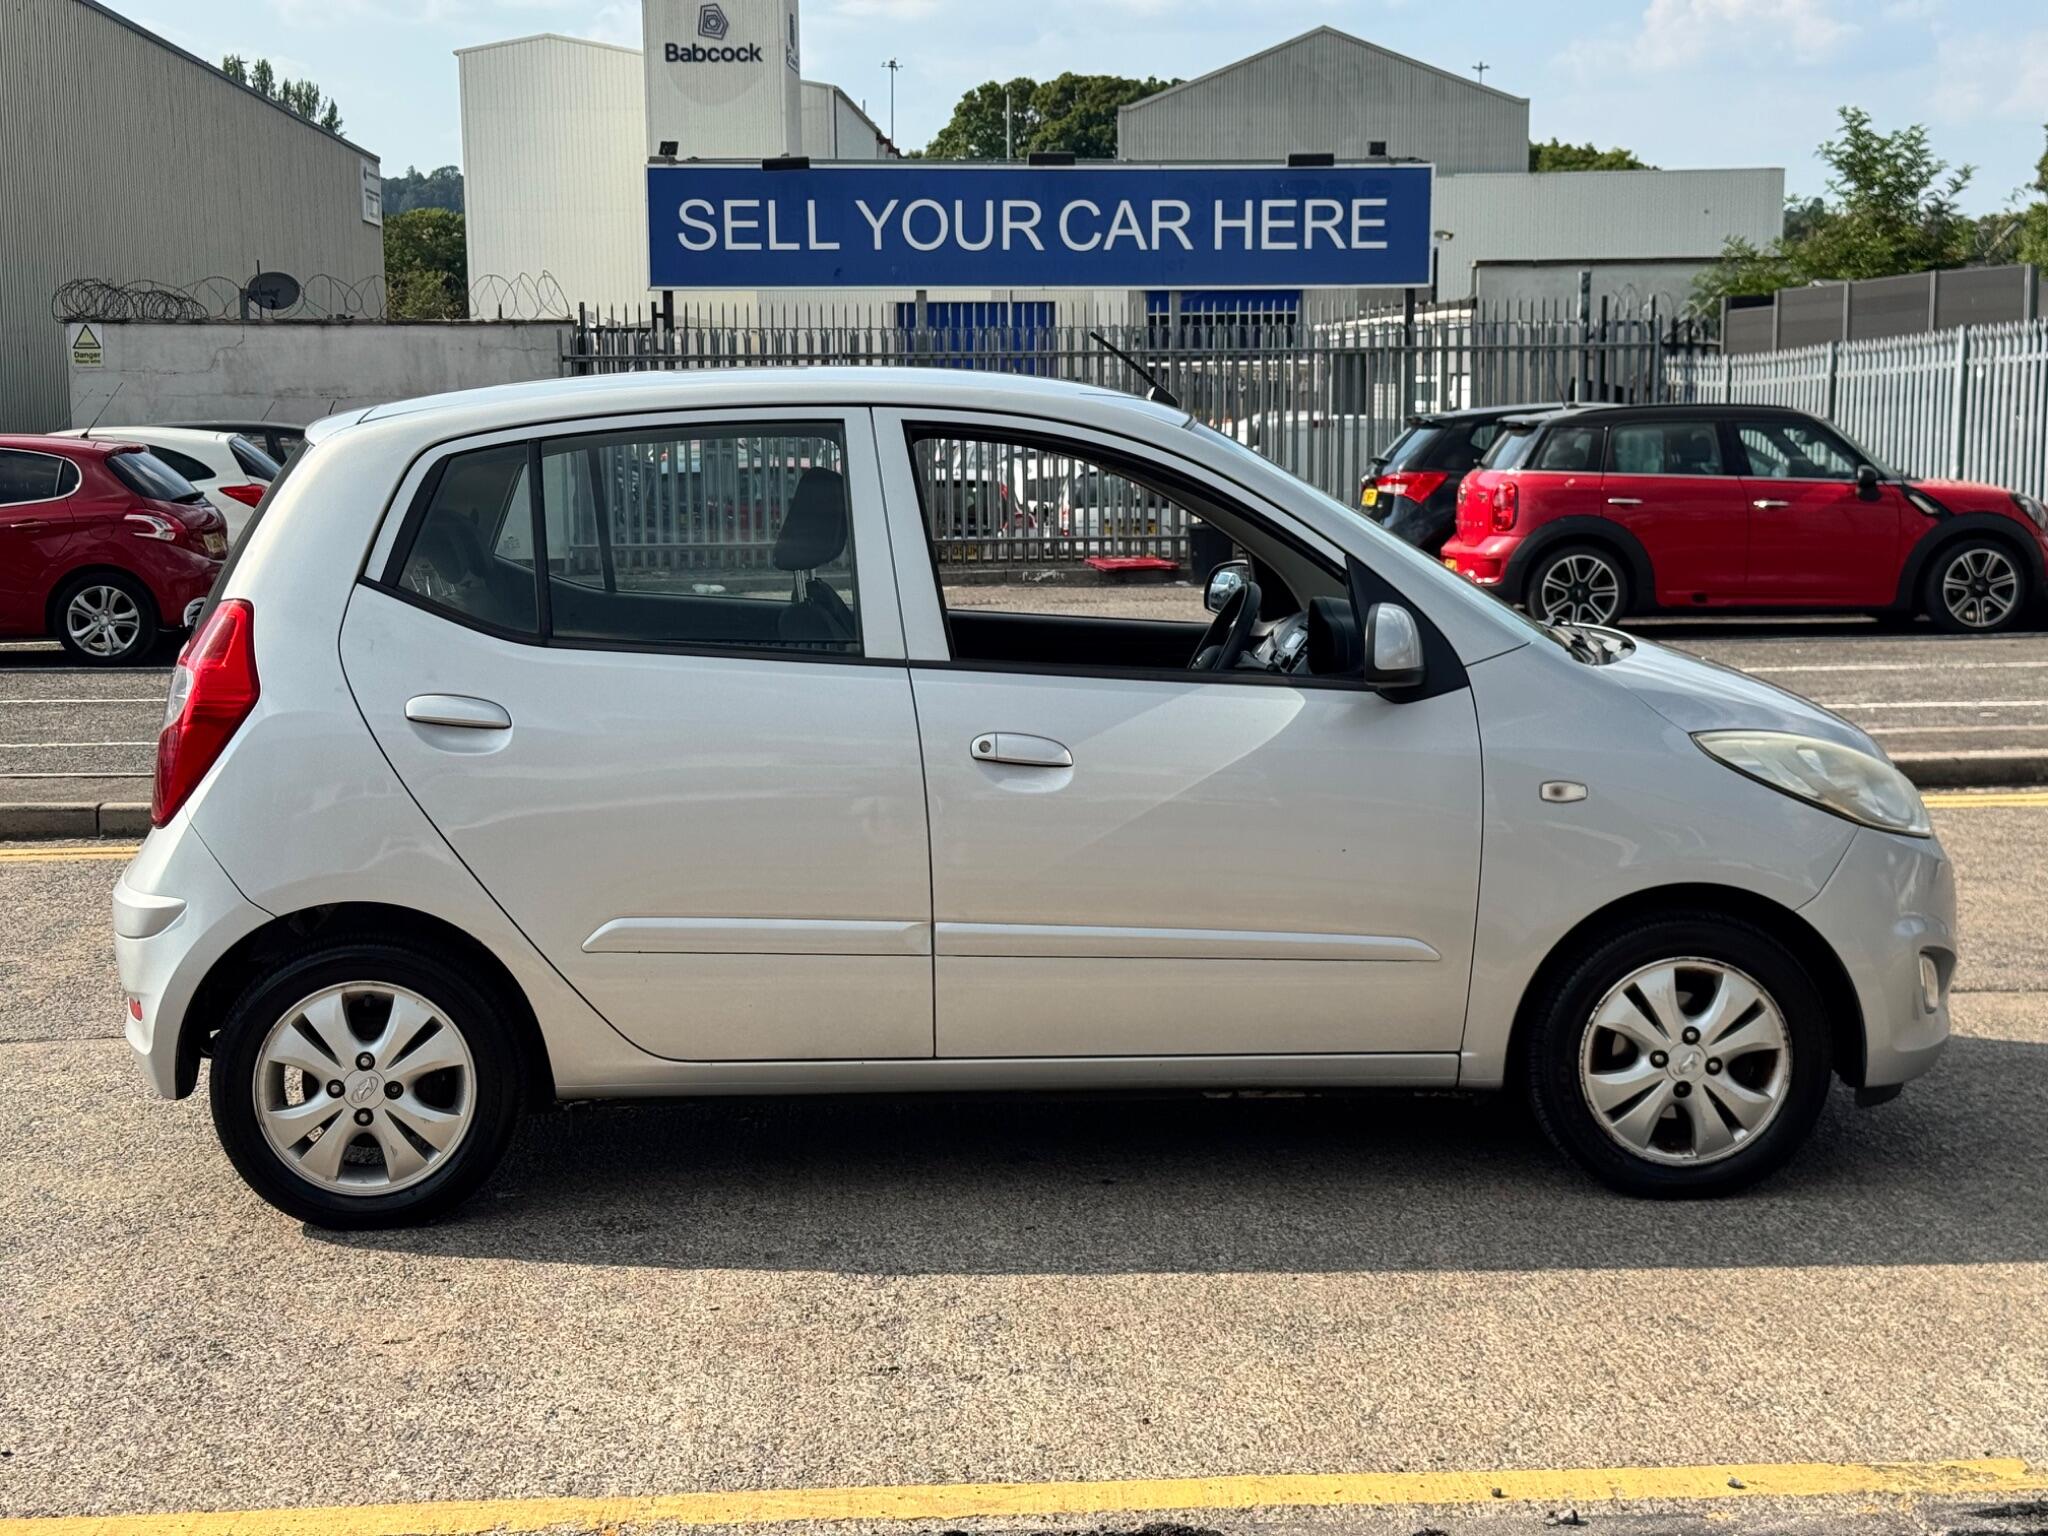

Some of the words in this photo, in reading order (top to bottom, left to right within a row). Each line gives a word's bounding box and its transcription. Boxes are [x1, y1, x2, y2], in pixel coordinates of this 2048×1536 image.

[665, 42, 763, 62] Babcock
[677, 198, 840, 251] SELL
[855, 198, 1045, 251] YOUR
[1058, 199, 1194, 251] CAR
[1214, 198, 1388, 250] HERE
[74, 351, 101, 359] Danger
